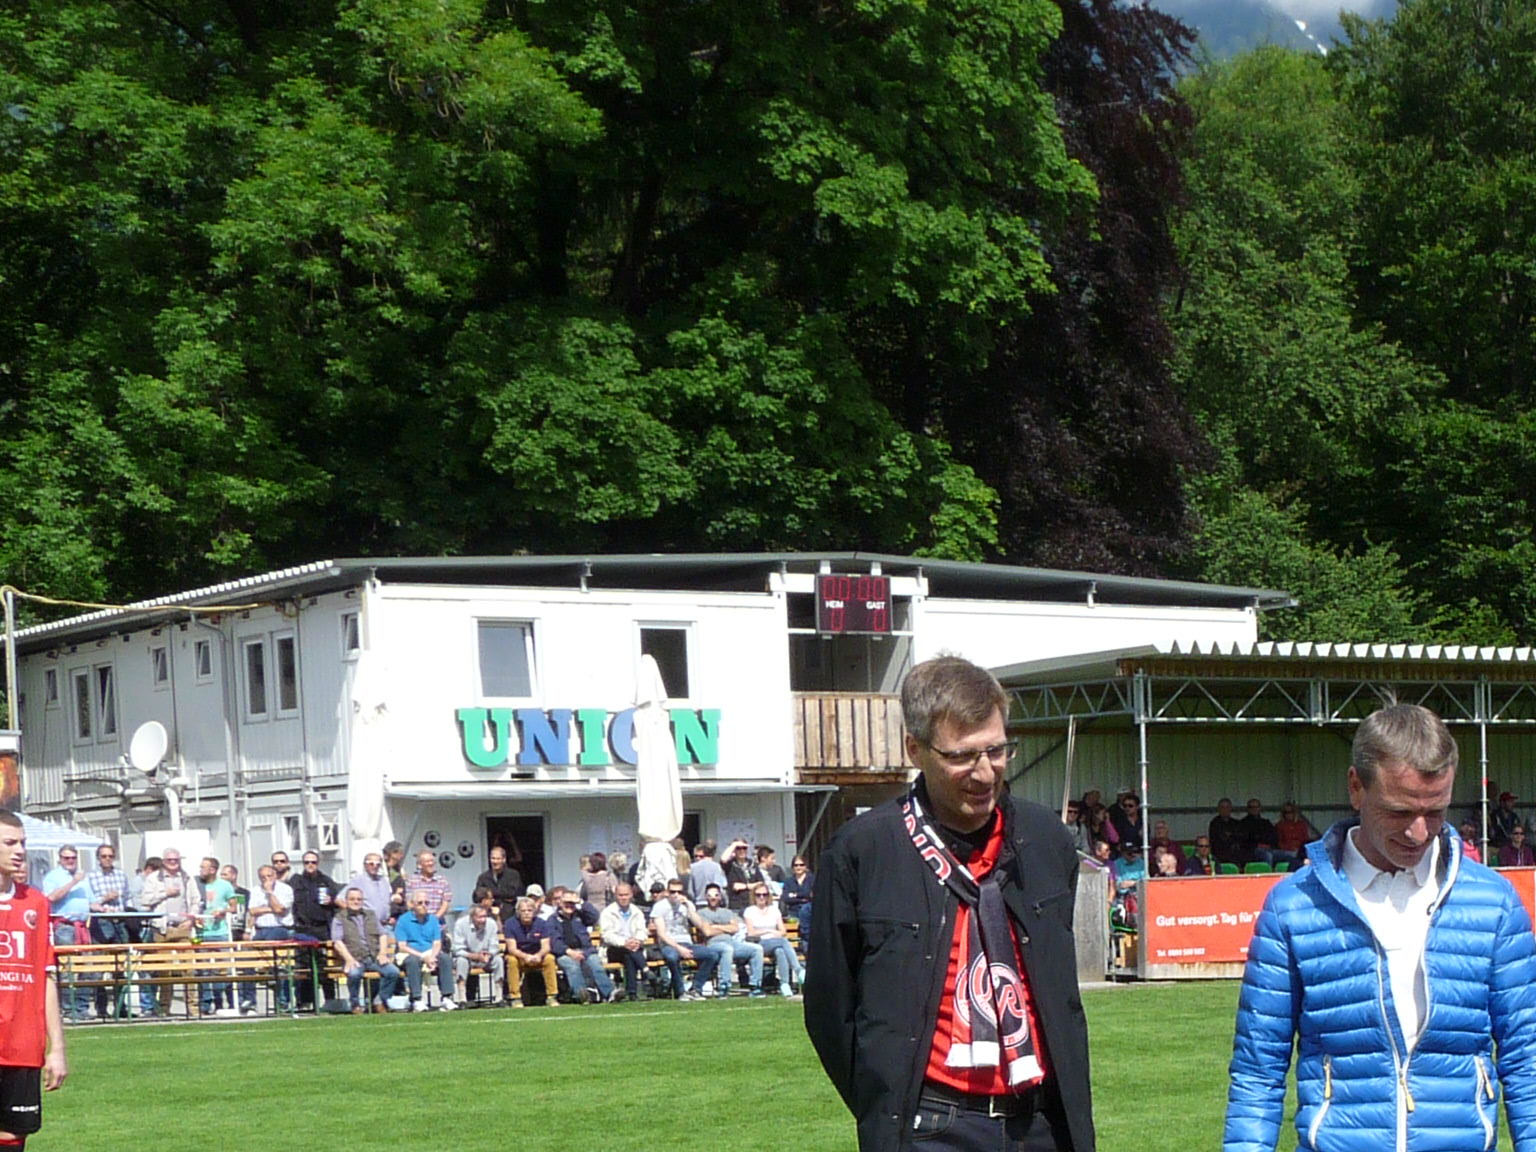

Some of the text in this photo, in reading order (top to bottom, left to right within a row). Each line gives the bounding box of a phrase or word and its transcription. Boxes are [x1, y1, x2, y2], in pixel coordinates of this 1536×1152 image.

[1156, 915, 1176, 927] Gut
[1177, 914, 1219, 928] versorgt.
[1220, 912, 1238, 925] Tag
